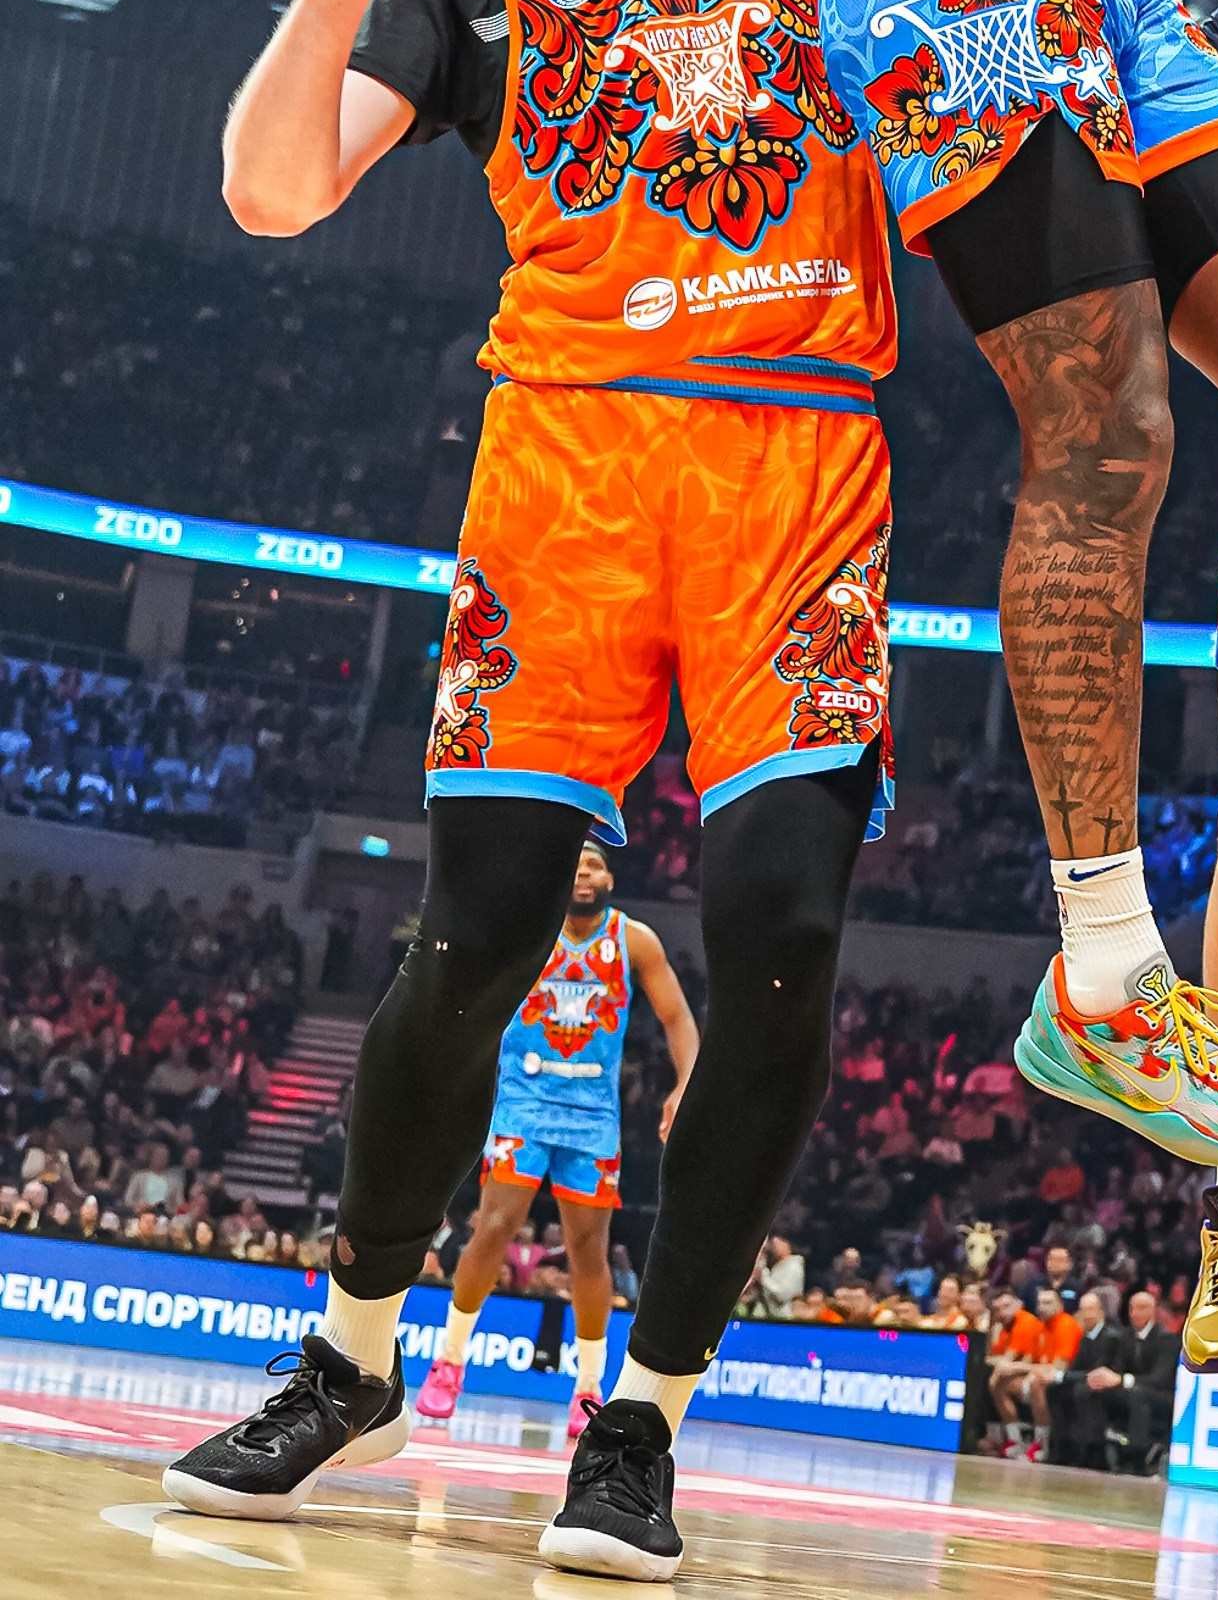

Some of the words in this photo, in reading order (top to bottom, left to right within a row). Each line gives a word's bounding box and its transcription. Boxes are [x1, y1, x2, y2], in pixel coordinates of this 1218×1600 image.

[682, 259, 852, 302] КАМКАБЕЛЬ
[94, 505, 183, 546] ZEDO
[255, 532, 344, 571] ZEDO
[416, 555, 458, 585] ZE
[889, 609, 972, 641] ZEDO
[816, 690, 872, 713] ZEDO
[0, 1272, 87, 1324] ЕНД
[93, 1283, 327, 1345] СПОРТИВНО
